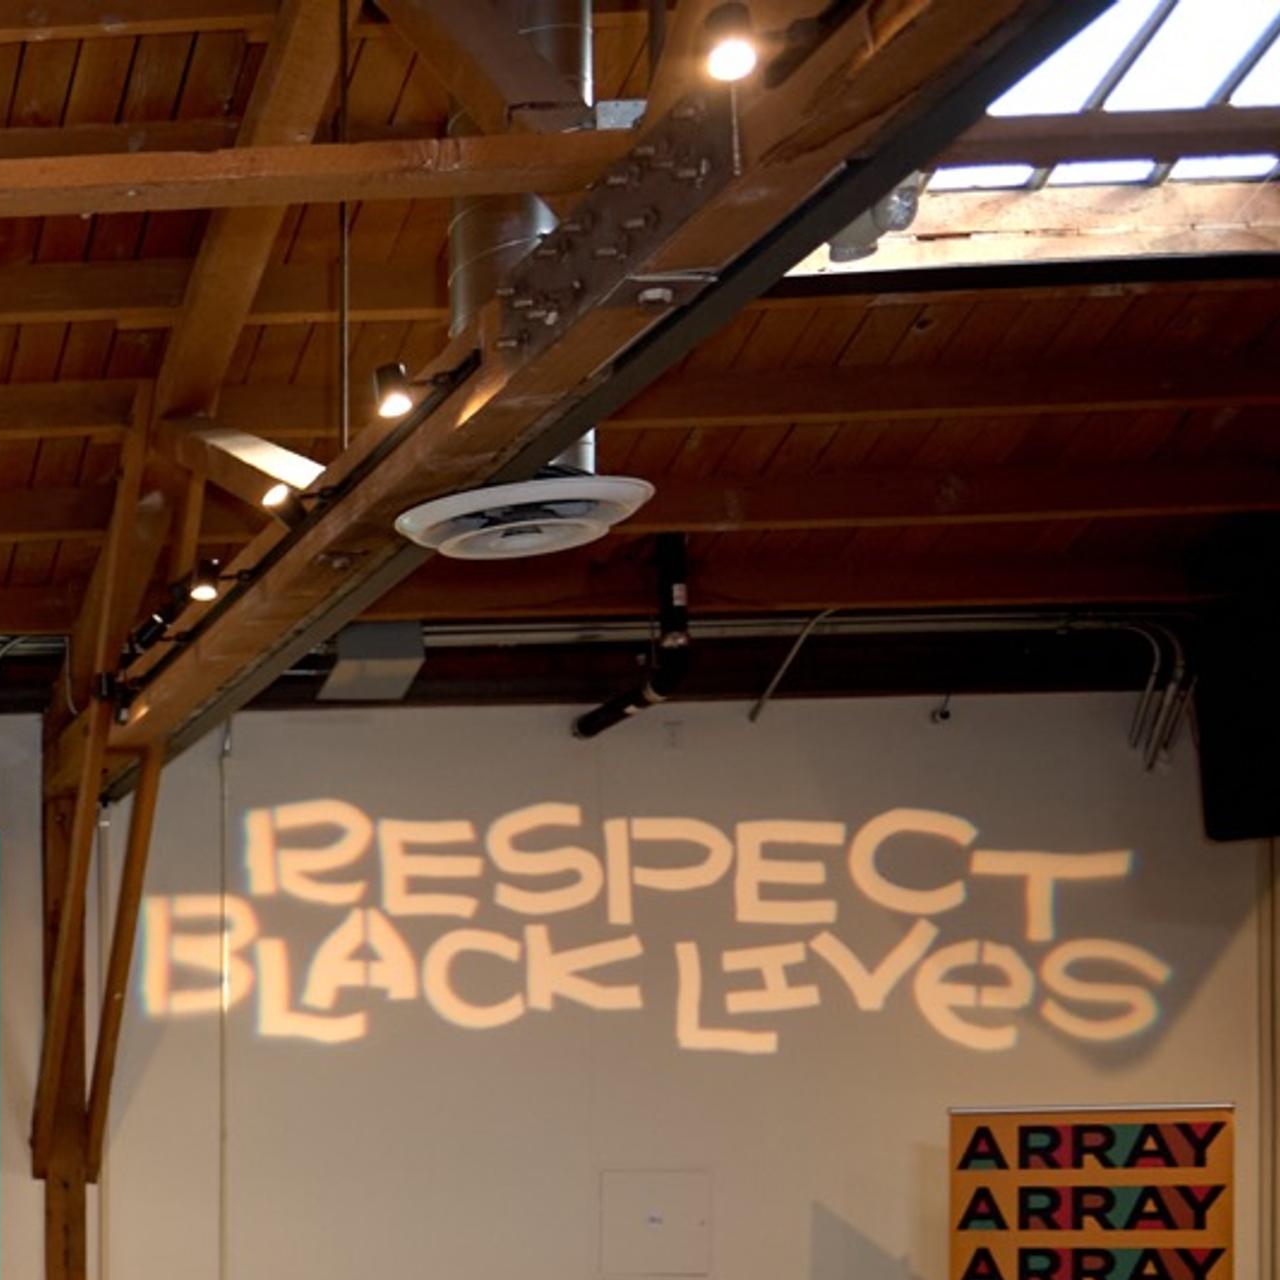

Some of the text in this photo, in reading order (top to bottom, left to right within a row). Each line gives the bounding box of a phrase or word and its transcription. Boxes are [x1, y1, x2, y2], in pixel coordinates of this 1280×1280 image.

[243, 798, 1134, 942] RESPECT
[140, 893, 644, 1044] BLACK
[956, 1122, 1226, 1170] ARRAY
[956, 1185, 1226, 1230] ARRAY
